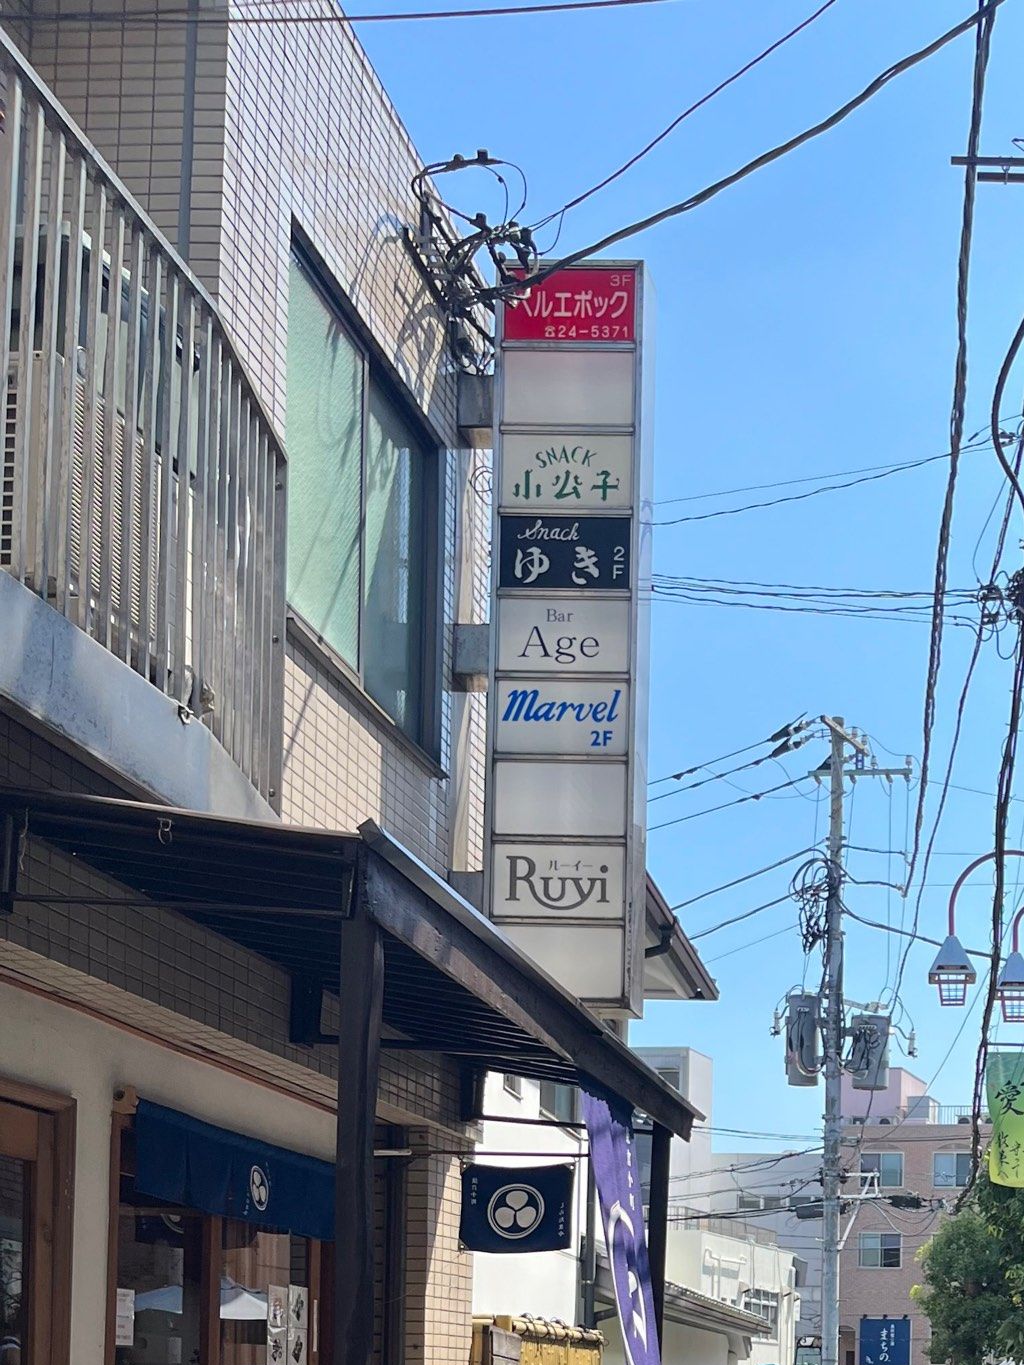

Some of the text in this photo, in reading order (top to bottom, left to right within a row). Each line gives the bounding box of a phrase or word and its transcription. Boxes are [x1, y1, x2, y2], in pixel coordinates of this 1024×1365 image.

[610, 274, 632, 287] 3F
[535, 445, 598, 469] SNACK
[512, 470, 620, 501] 小公子
[517, 519, 580, 541] Snack
[514, 546, 600, 585] ゆき
[612, 546, 625, 580] 2F
[546, 608, 574, 623] Bar
[517, 626, 600, 664] Age
[590, 731, 613, 747] 2F
[505, 855, 610, 911] Ruyi
